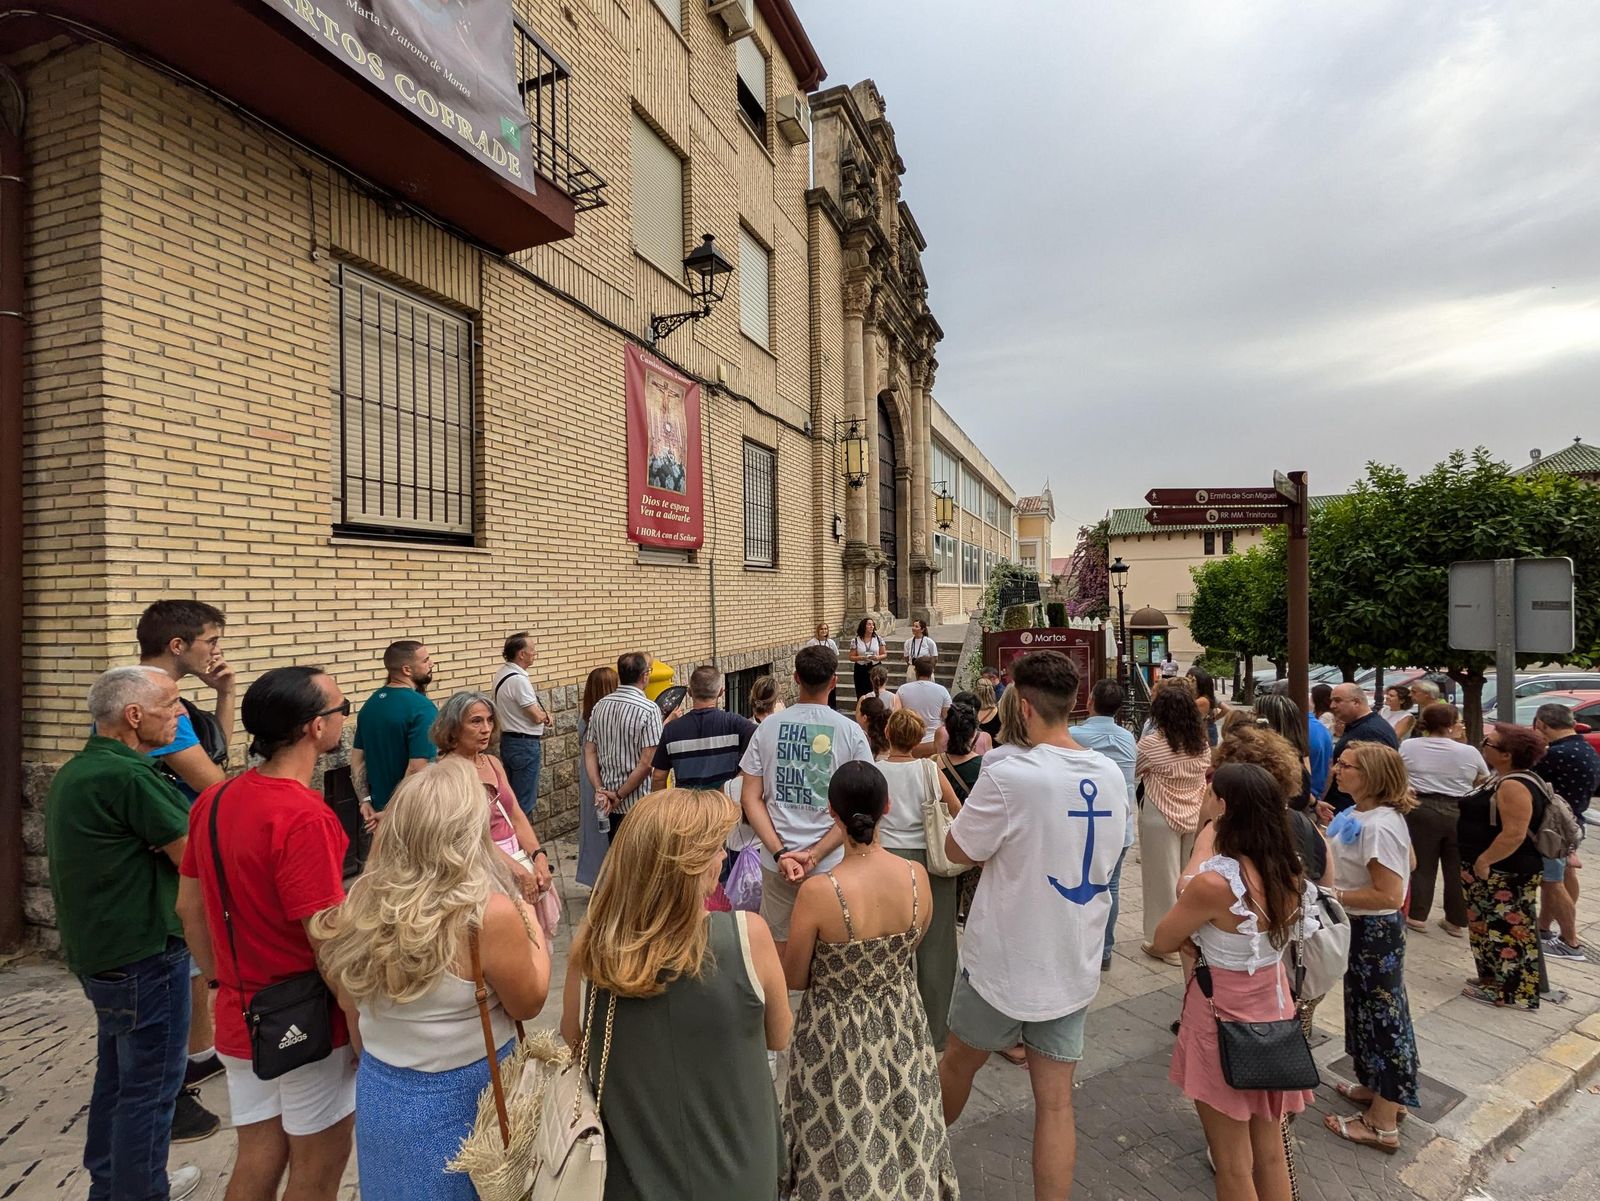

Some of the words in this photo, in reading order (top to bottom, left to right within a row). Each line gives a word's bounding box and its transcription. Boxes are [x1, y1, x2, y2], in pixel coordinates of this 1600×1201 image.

[346, 0, 380, 27] Marta
[390, 26, 429, 63] Patrona
[430, 60, 441, 73] de
[442, 68, 471, 98] Martos
[283, 0, 385, 81] RTOS
[394, 73, 522, 179] COFRADE
[641, 494, 660, 507] Dios
[661, 499, 669, 508] te
[670, 502, 690, 513] espera
[1210, 492, 1231, 500] Ermita
[1254, 492, 1277, 501] Miguel
[640, 505, 654, 517] Ven
[656, 510, 661, 518] a
[663, 510, 690, 523] adorarle
[640, 527, 661, 538] HORA
[661, 532, 672, 540] con
[673, 532, 679, 540] el
[679, 532, 697, 542] Señor
[1034, 634, 1067, 642] Martos
[779, 724, 808, 743] CHA
[777, 742, 811, 763] SING
[776, 766, 805, 787] SUN
[775, 784, 812, 805] SETS
[278, 1033, 308, 1049] adidas
